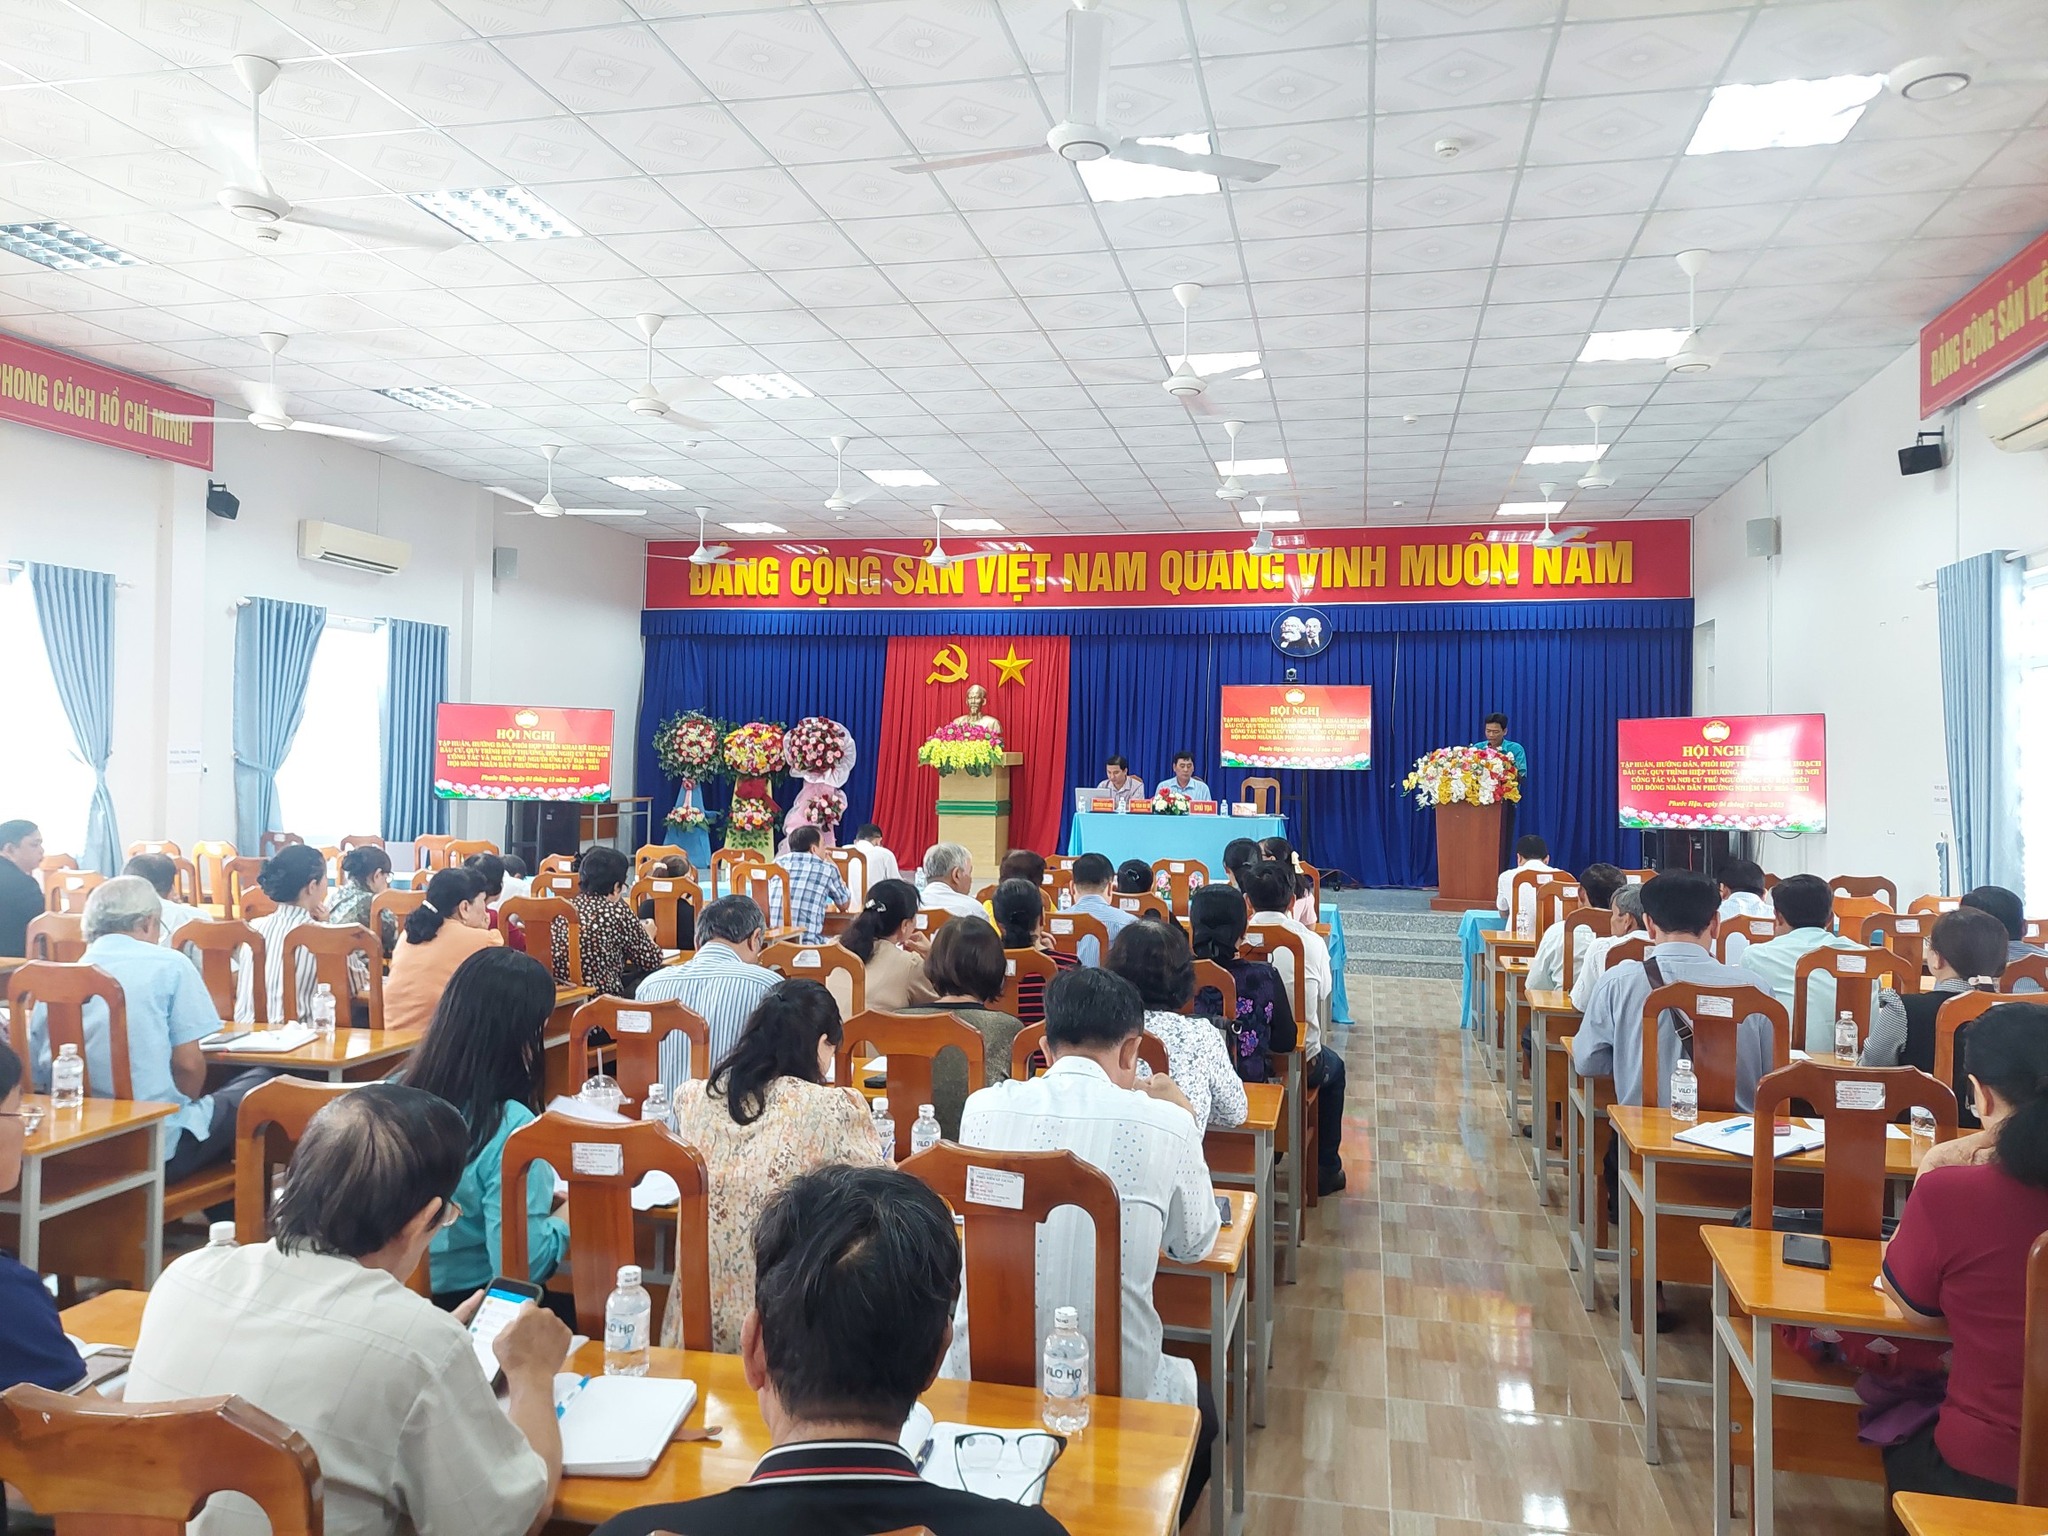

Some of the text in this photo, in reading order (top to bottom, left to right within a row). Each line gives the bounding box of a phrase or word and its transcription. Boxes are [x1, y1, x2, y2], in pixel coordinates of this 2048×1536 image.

[1930, 332, 1961, 387] ĐẢNG
[1962, 308, 1996, 369] CỘNG
[1997, 280, 2026, 341] SẢN
[0, 363, 193, 447] HONG CÁCH HỒ CHÍ MINH!
[689, 542, 779, 597] ĐẢNG
[789, 548, 883, 604] CỘNG
[892, 539, 965, 595] SẢN
[977, 542, 1051, 602] VIỆT
[1062, 551, 1148, 592] NAM
[1159, 548, 1285, 595] QUANG
[1296, 546, 1386, 589] VINH
[1399, 532, 1519, 587] MUÔN
[1270, 706, 1320, 718] HỘI NGHỊ
[496, 728, 556, 744] HỘI NGHỊ
[1682, 744, 1710, 760] HỘI
